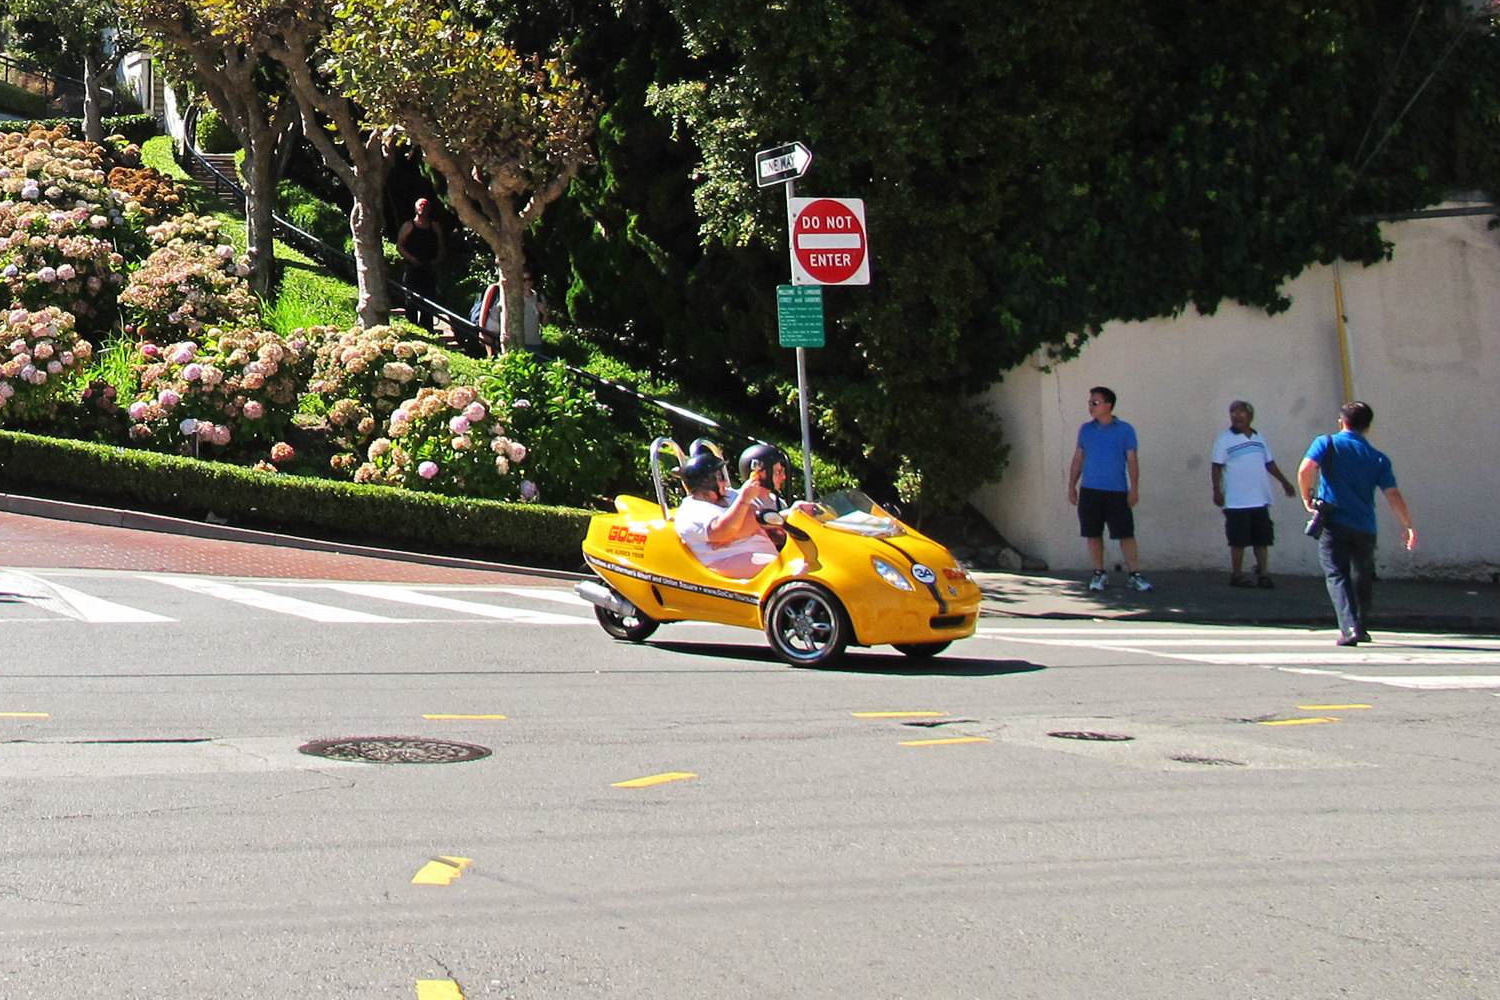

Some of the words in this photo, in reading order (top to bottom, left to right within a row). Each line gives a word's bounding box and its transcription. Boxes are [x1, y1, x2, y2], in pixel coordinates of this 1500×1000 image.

[763, 159, 779, 174] ONE
[780, 153, 795, 170] WAY
[802, 216, 820, 229] DO
[826, 216, 852, 229] NOT
[809, 253, 852, 267] ENTER
